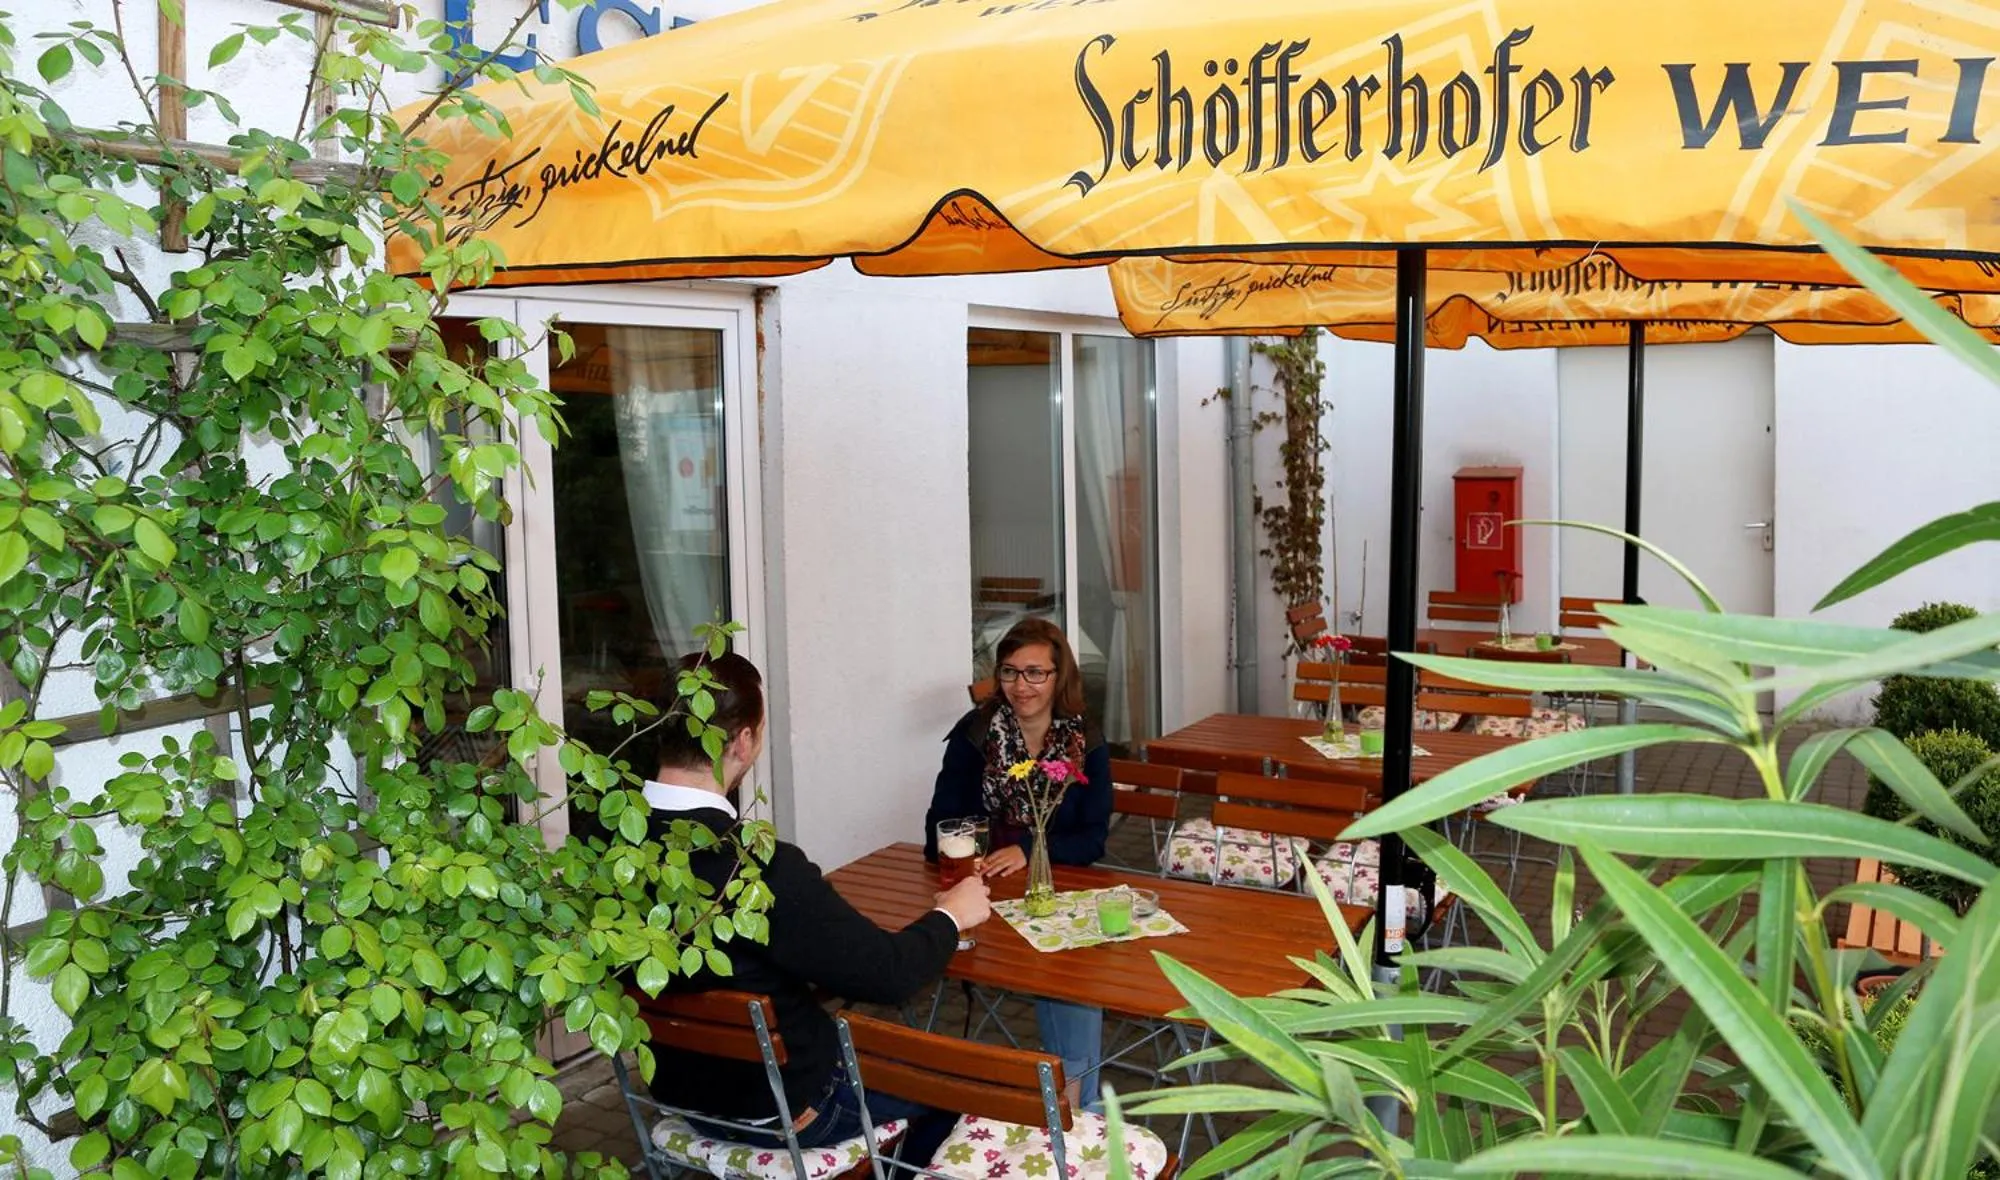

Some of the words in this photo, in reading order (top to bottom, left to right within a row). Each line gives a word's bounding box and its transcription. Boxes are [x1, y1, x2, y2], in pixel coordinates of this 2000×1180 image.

[513, 92, 730, 229] prickelnd
[1062, 25, 1616, 198] Schöfferhofer
[1660, 57, 1996, 150] WEI
